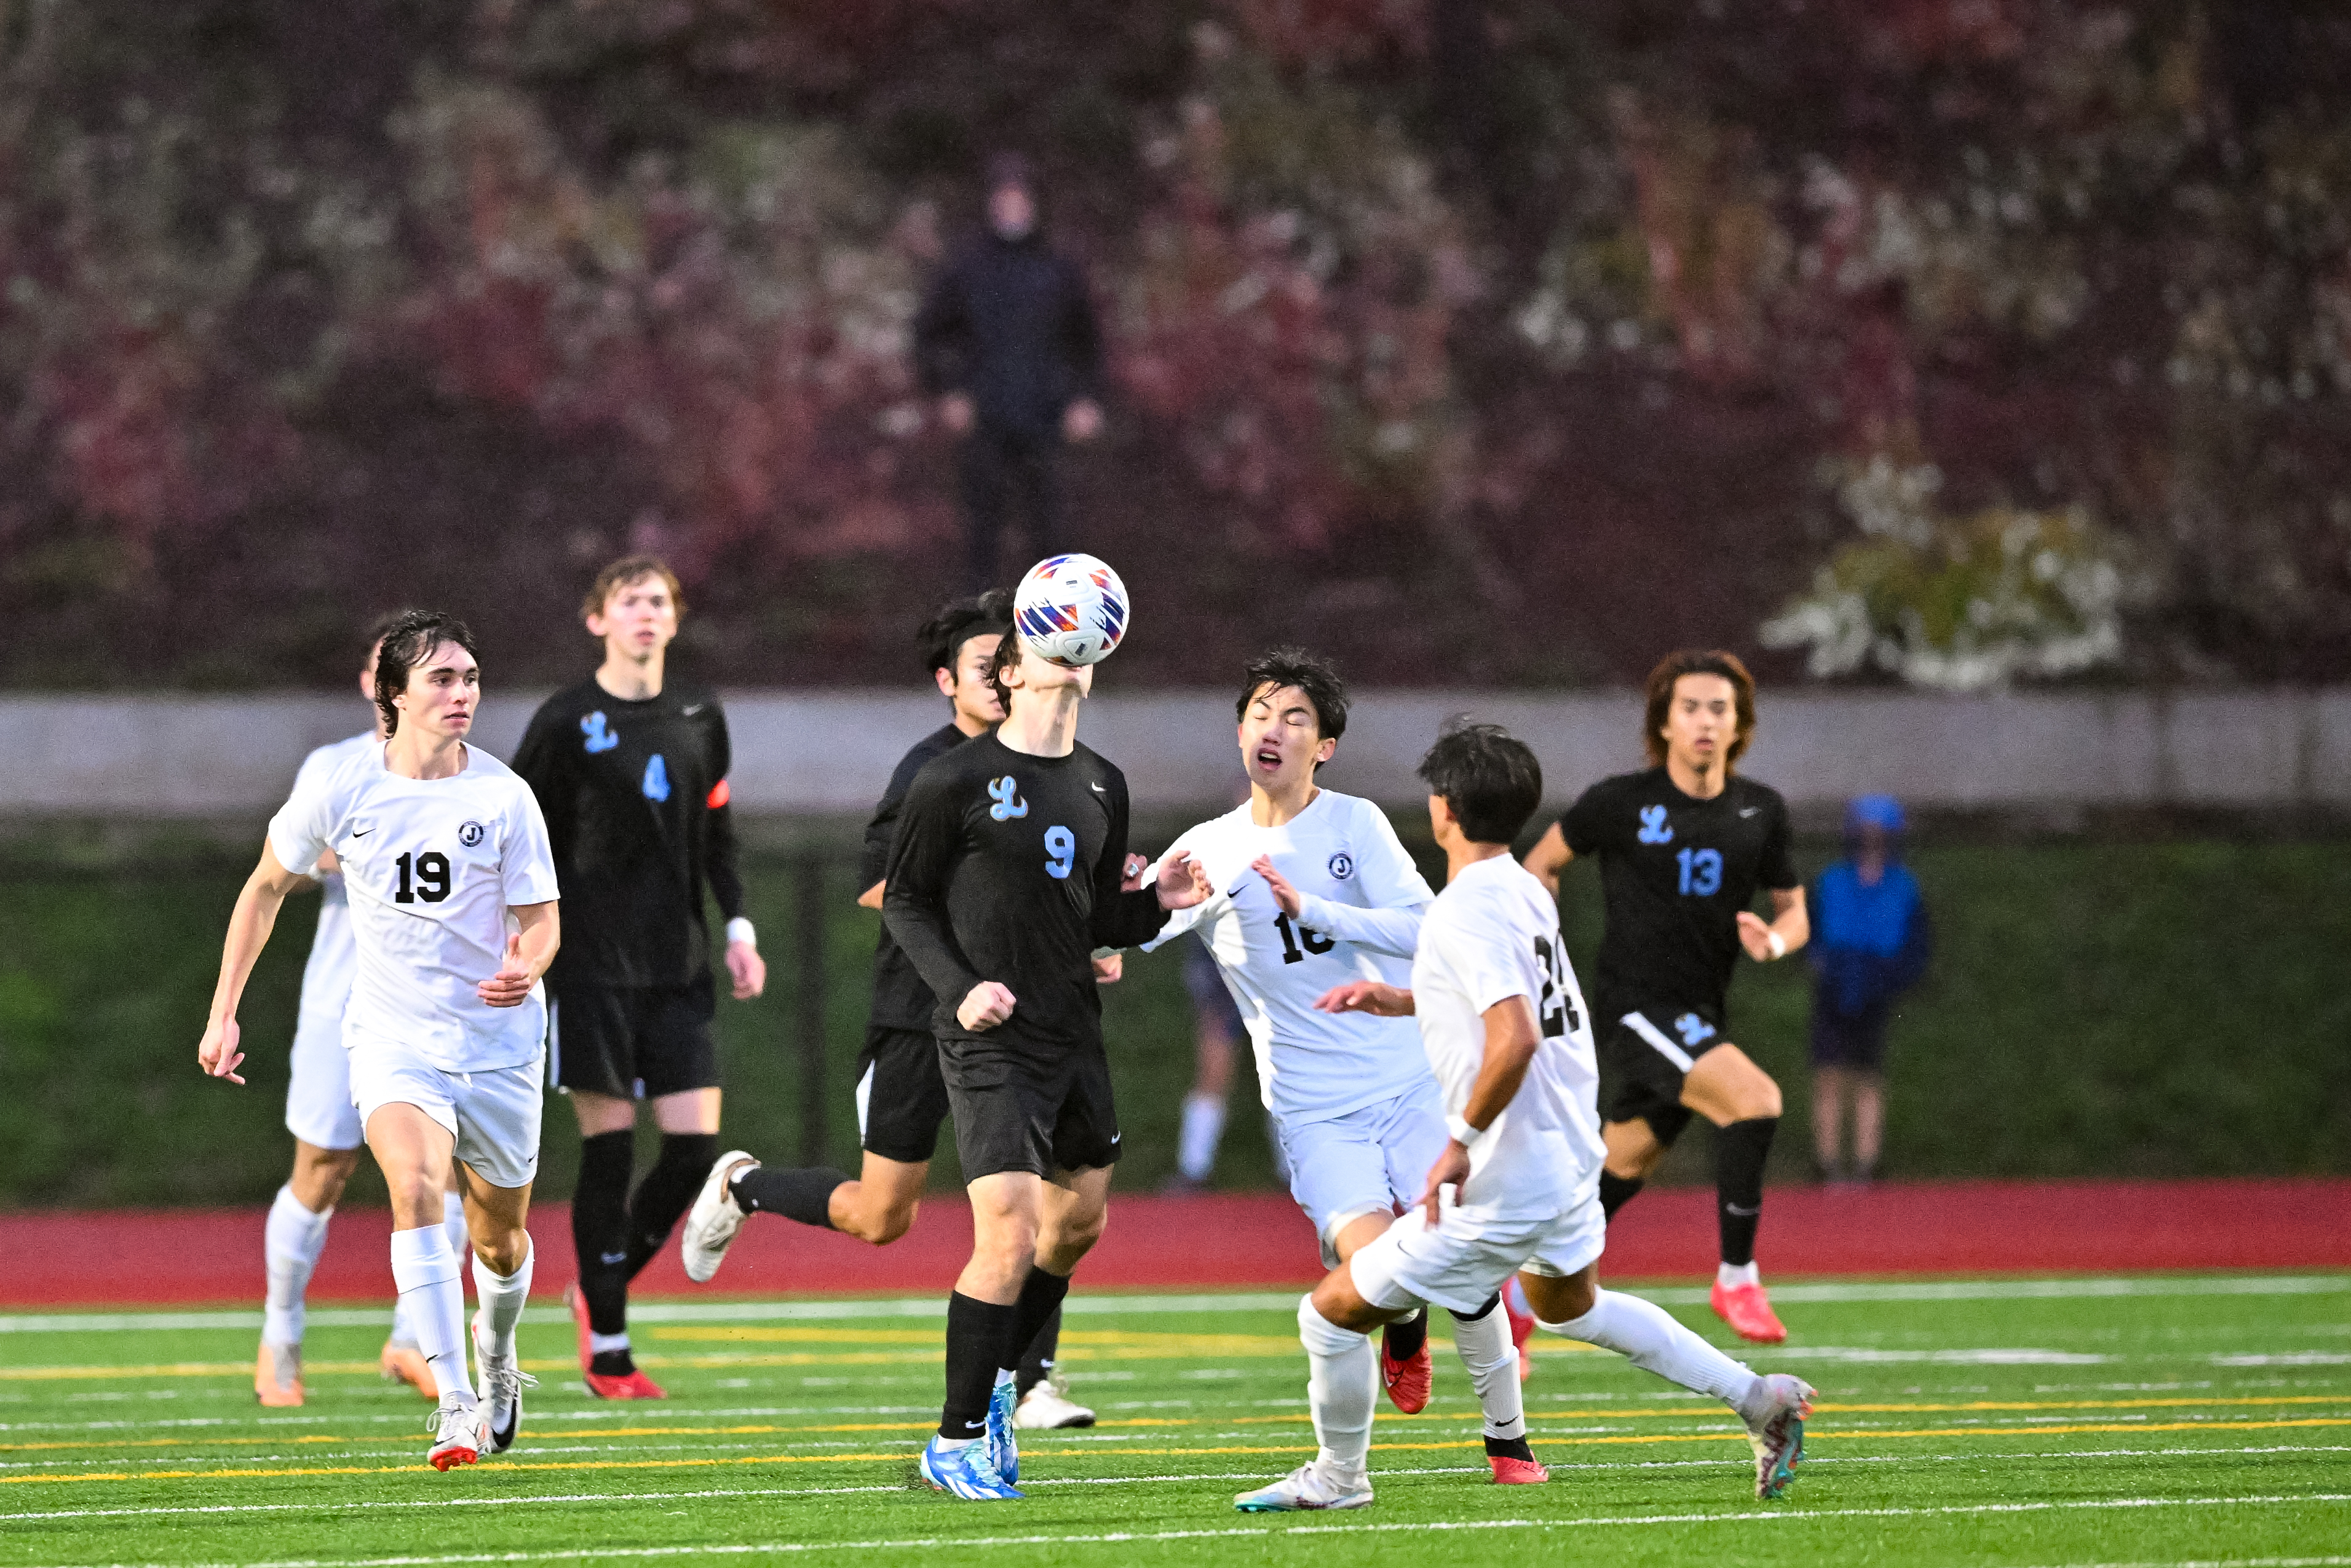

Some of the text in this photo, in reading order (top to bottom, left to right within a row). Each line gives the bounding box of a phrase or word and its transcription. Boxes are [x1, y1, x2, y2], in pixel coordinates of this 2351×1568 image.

[643, 753, 672, 803] 4
[988, 775, 1028, 821] L
[467, 827, 477, 841] J
[1044, 826, 1075, 879] 9
[395, 852, 450, 903] 19
[1337, 859, 1346, 873] J
[1676, 847, 1724, 896] 13
